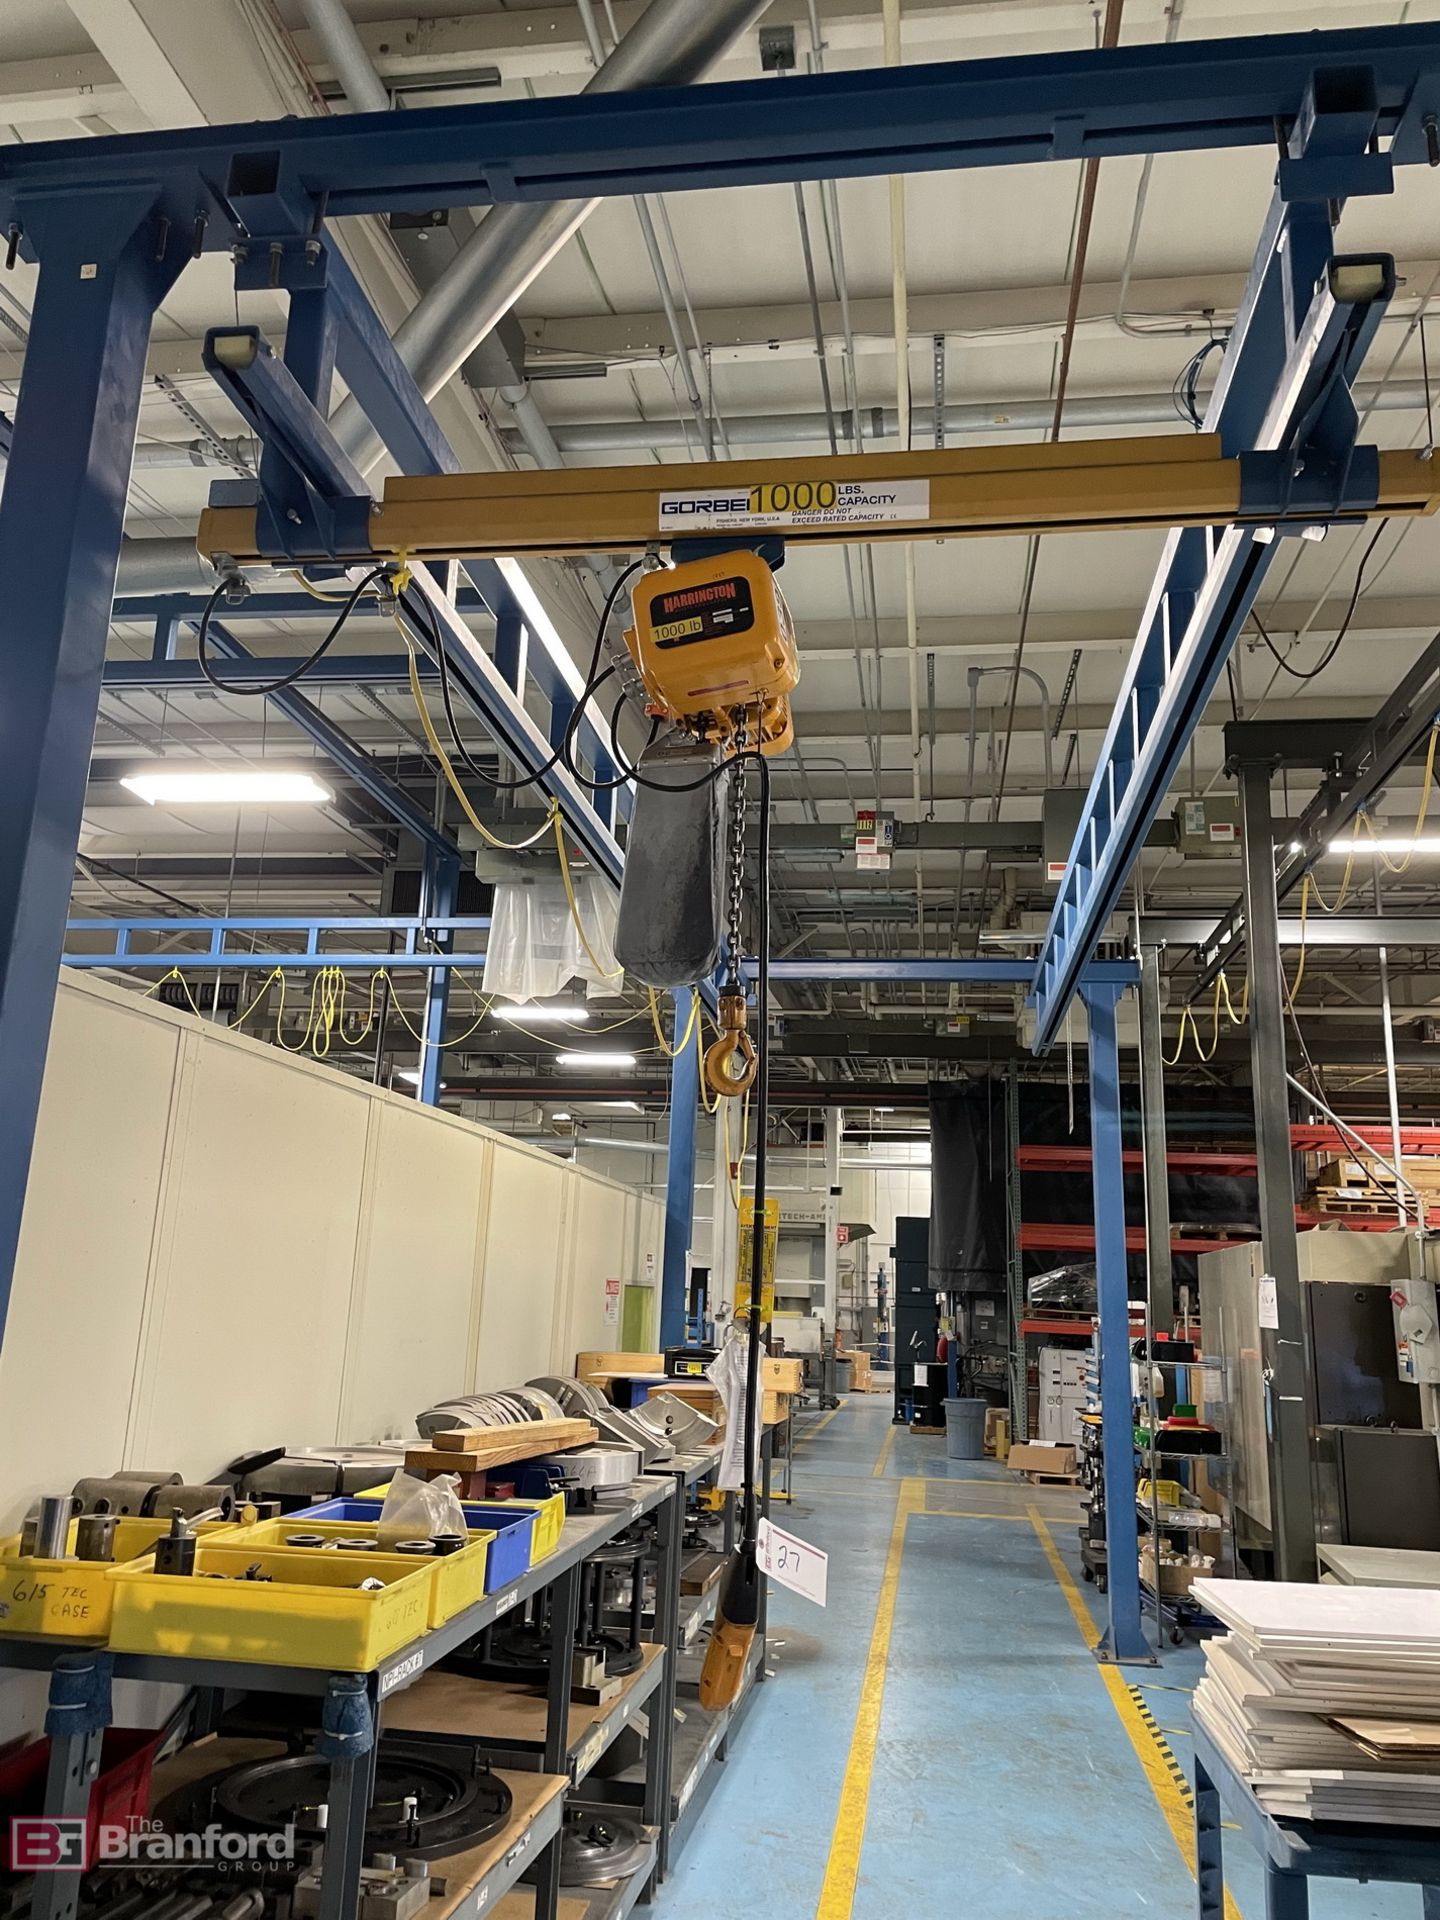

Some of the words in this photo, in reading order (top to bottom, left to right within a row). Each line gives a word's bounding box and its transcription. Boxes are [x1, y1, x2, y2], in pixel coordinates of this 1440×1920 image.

[751, 481, 837, 513] 1000
[838, 486, 864, 495] LBS.
[661, 499, 750, 515] GORBE
[838, 495, 896, 506] CAPACITY
[792, 508, 824, 517] DANGER
[848, 513, 885, 521] CAPACITY
[663, 583, 737, 614] HARRINGTON
[654, 622, 686, 641] 1000
[689, 619, 701, 632] lb
[778, 1545, 800, 1573] 27
[62, 1586, 88, 1599] TEC
[50, 1603, 89, 1619] CASE
